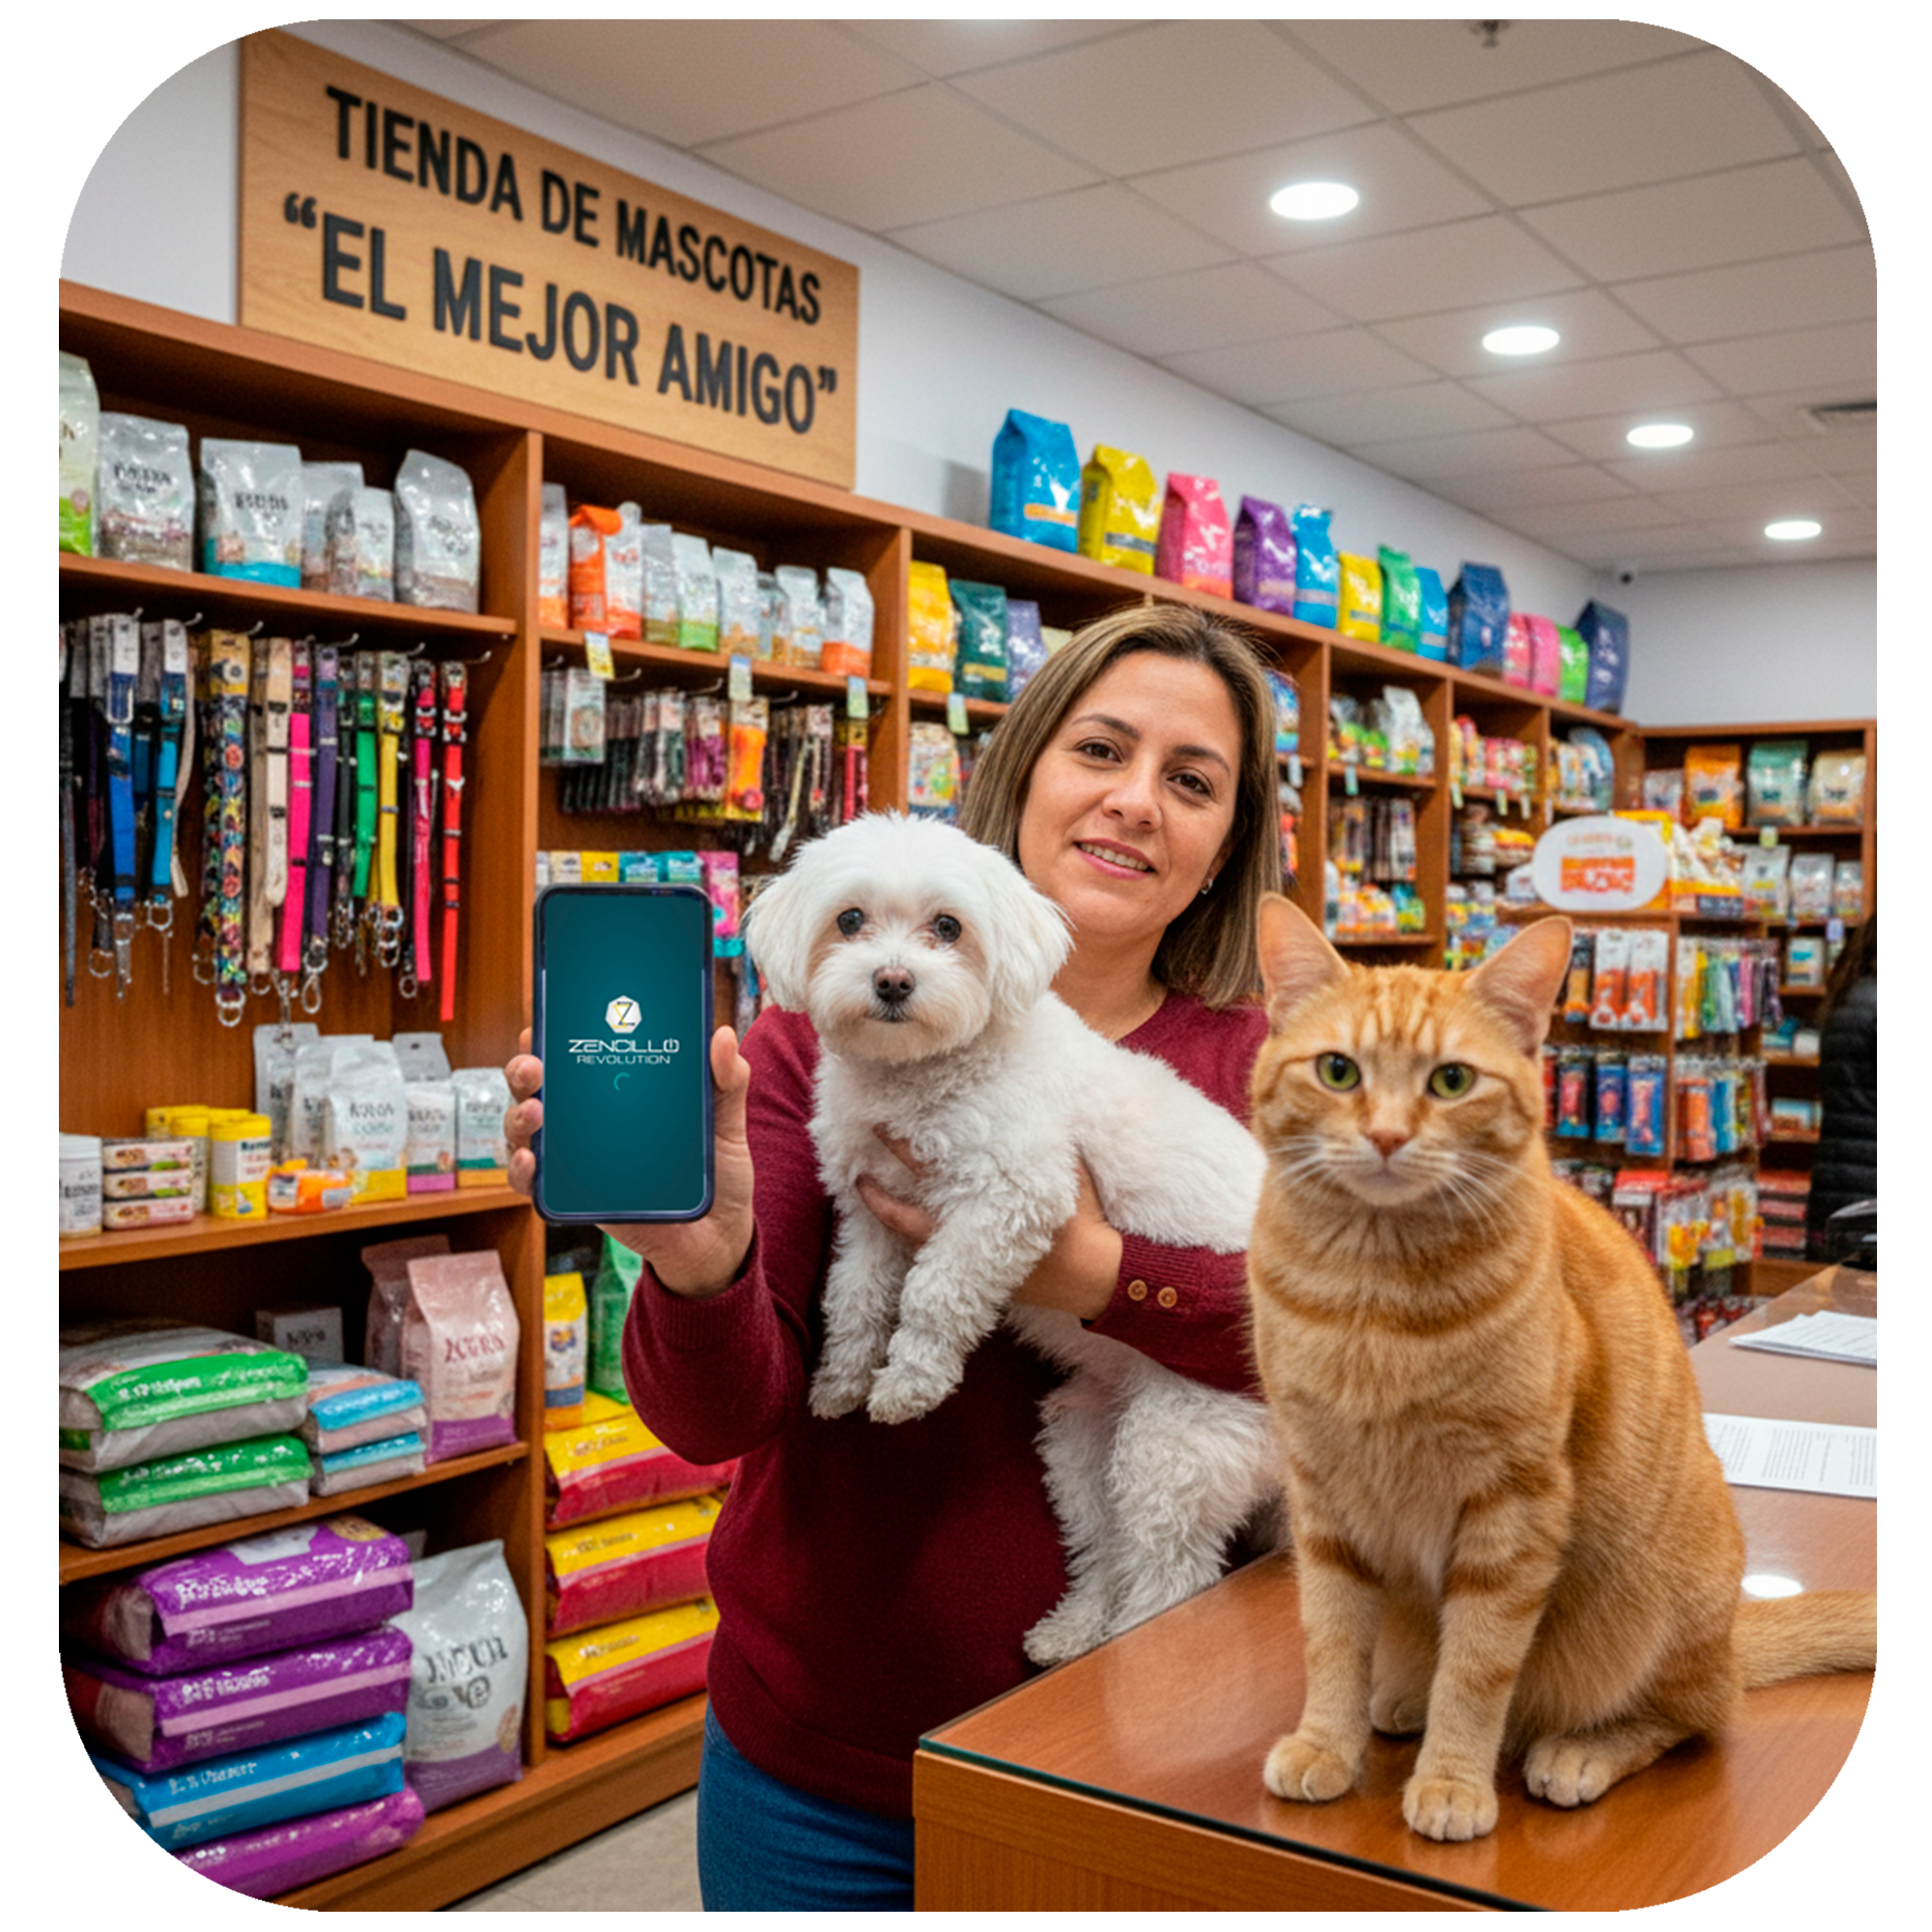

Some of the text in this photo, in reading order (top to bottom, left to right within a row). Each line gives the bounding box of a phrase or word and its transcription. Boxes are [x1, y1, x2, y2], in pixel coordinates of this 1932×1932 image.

[323, 83, 822, 327] TIENDA DE MASCOTAS
[283, 192, 838, 434] “EL MEJOR AMIGO”
[568, 1038, 680, 1053] ZENCILLO
[577, 1055, 671, 1065] REVOLUTION
